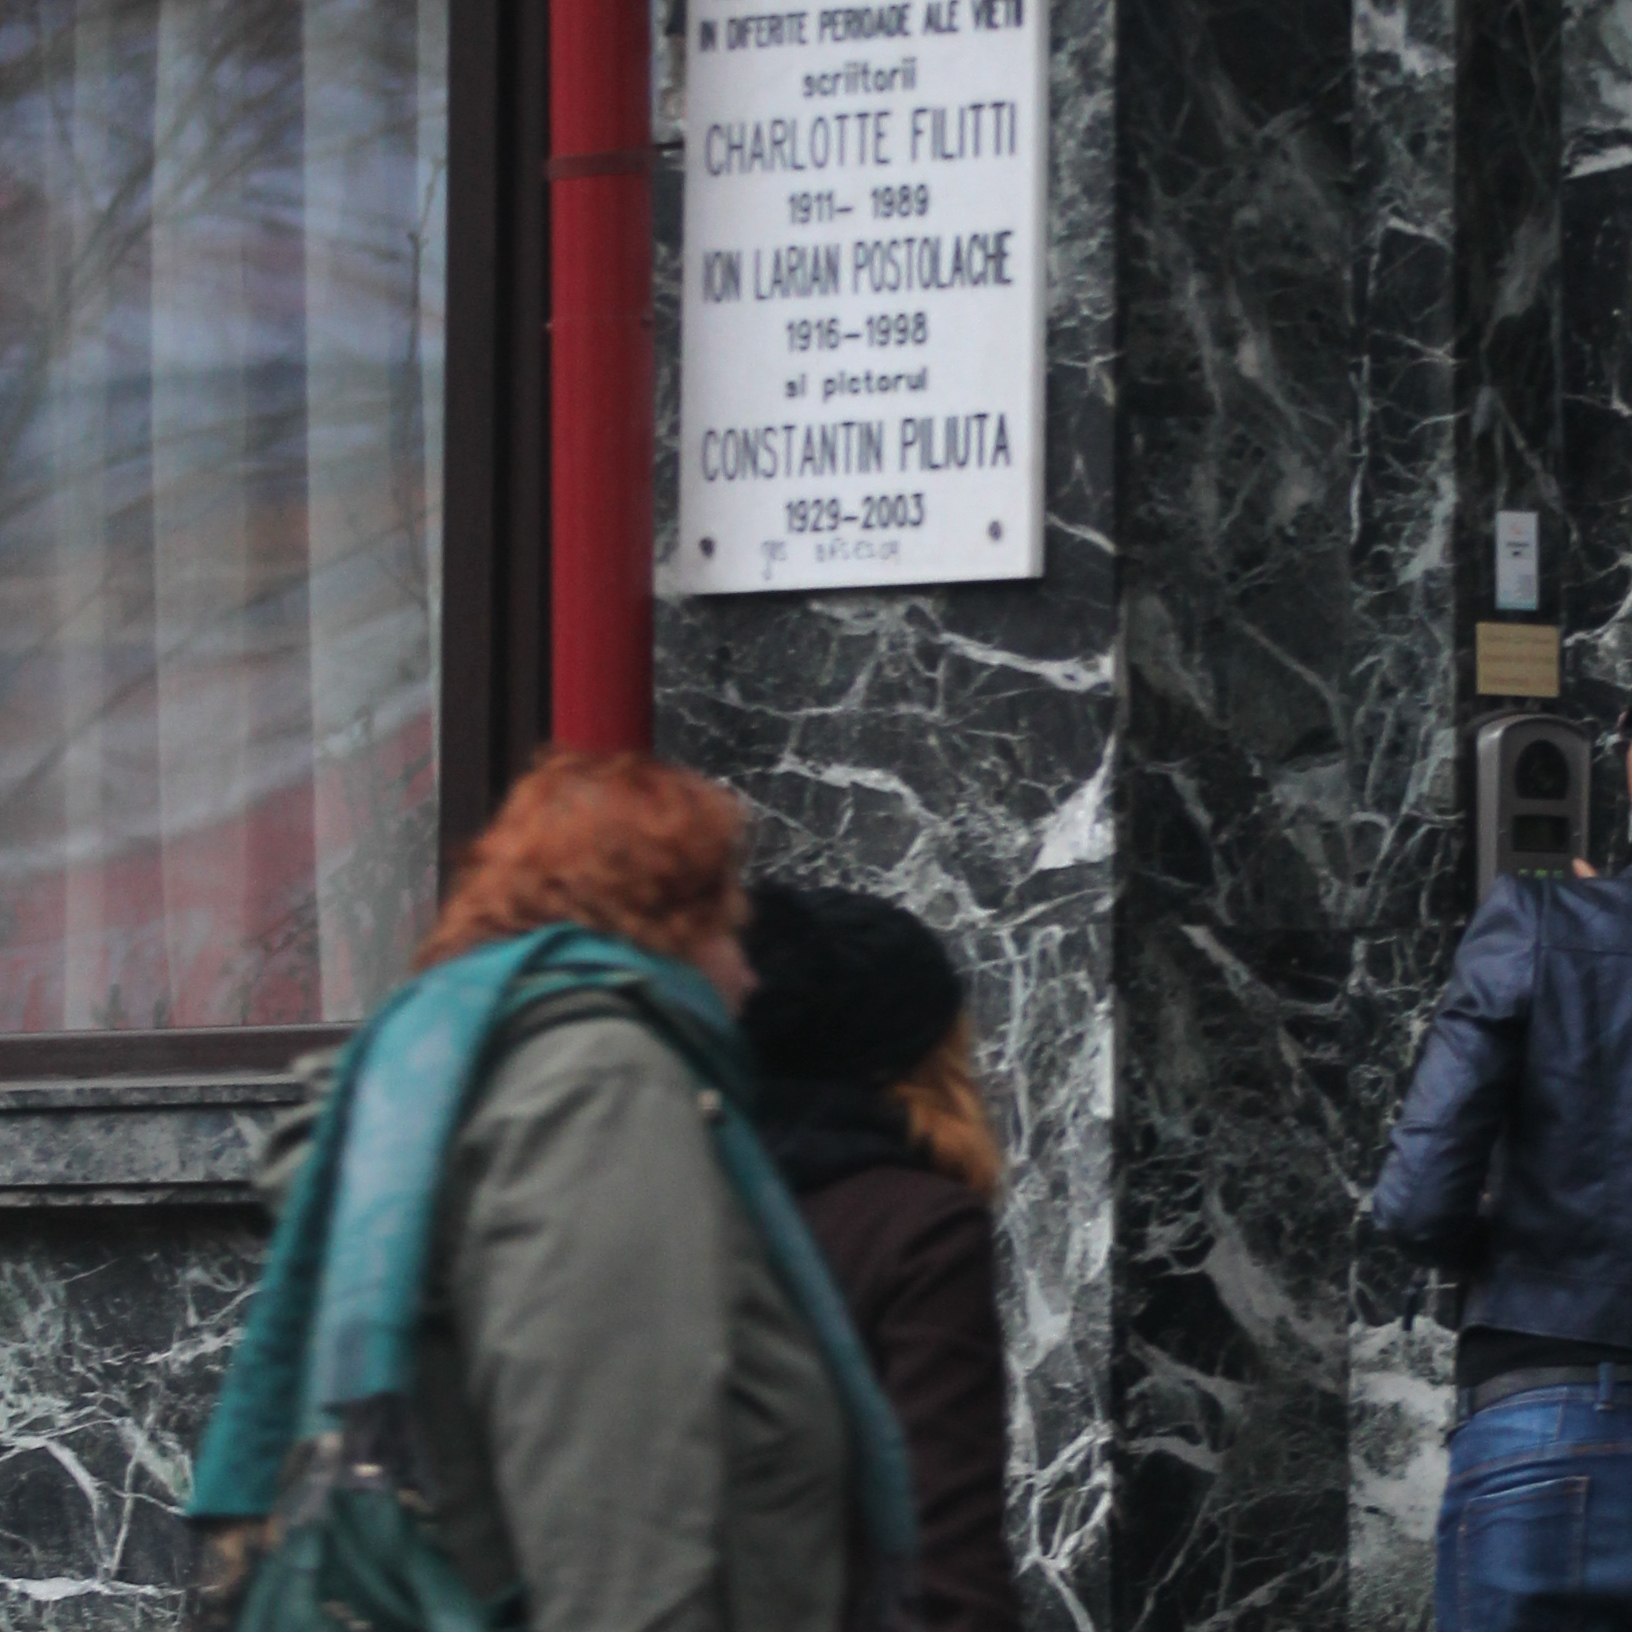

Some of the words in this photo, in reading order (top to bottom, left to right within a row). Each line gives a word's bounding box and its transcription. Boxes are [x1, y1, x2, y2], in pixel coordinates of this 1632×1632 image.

[727, 11, 808, 50] DIFERITE
[819, 2, 911, 45] PERIOADE
[803, 57, 918, 97] scriitorii
[705, 111, 891, 176] CHARLOTTE
[910, 102, 1017, 163] FILITTI
[703, 250, 742, 303] ION
[754, 244, 840, 300] LARIAN
[852, 230, 1014, 295] POSTOLACHE
[823, 367, 928, 402] pictorul
[702, 421, 884, 482] CONSTANTIN
[901, 413, 1012, 471] PILIUTA
